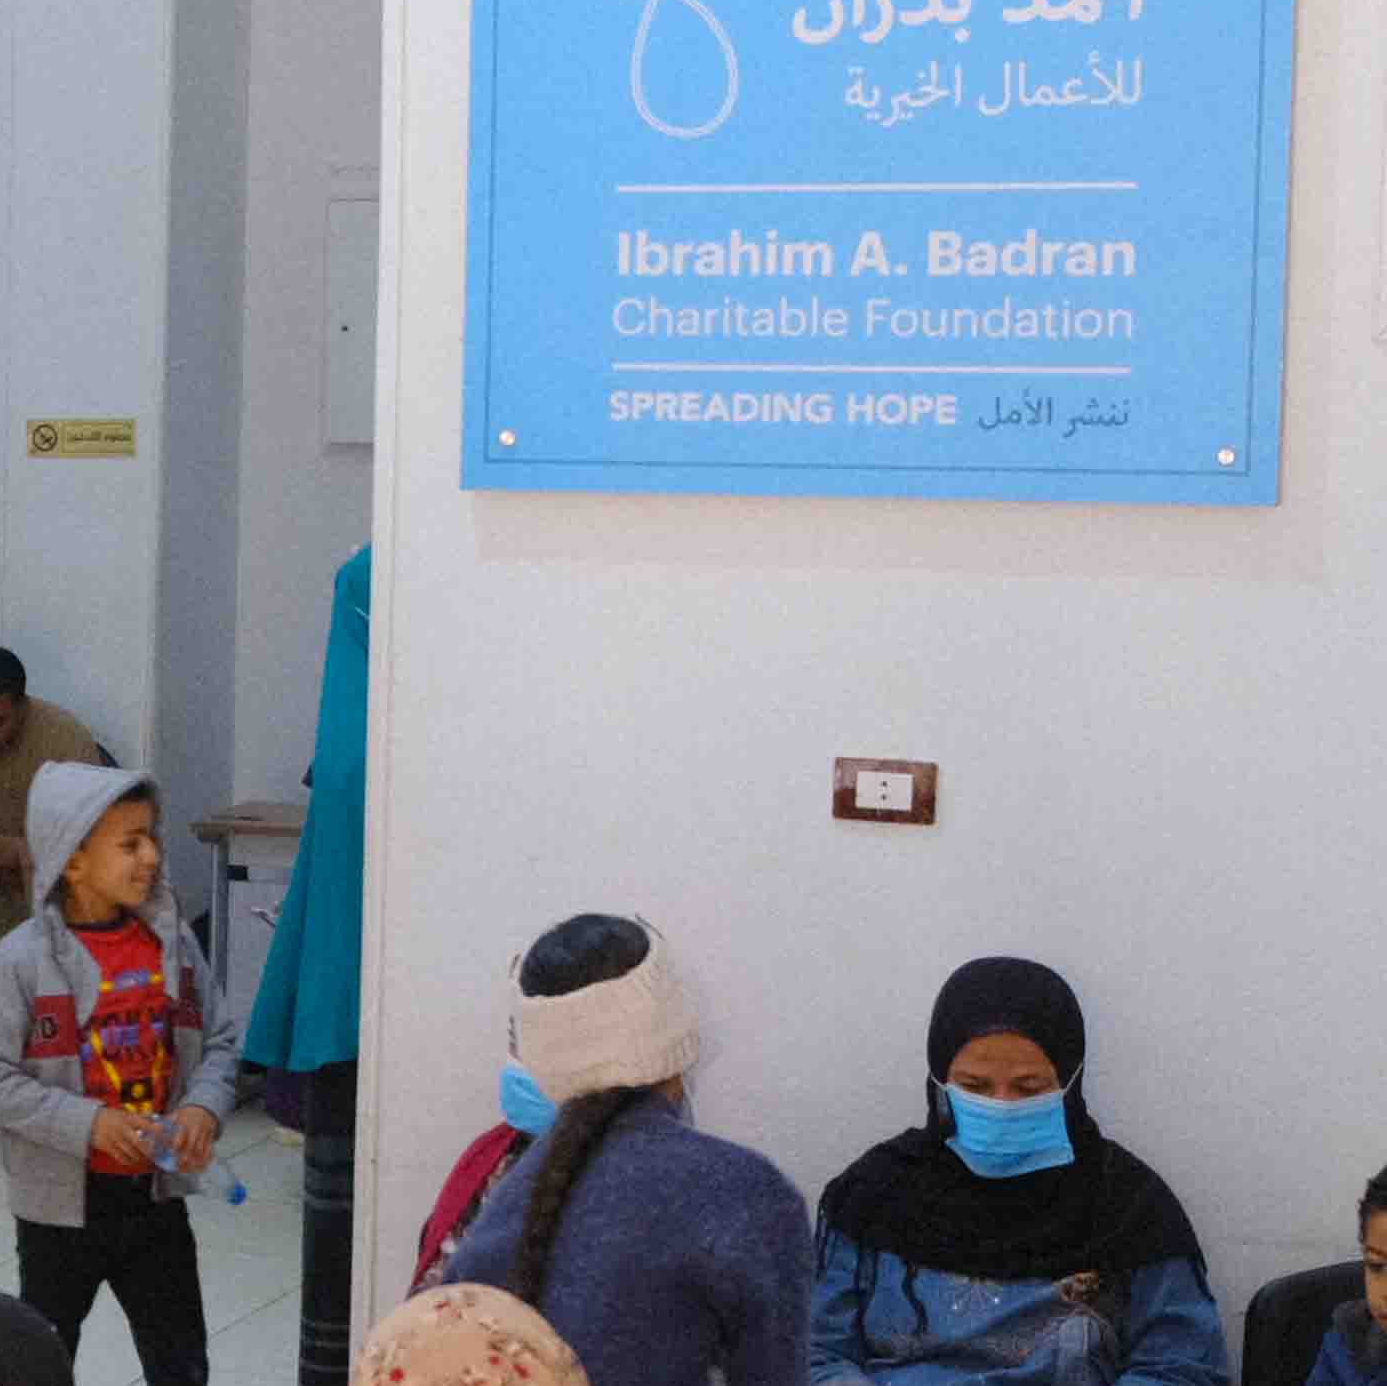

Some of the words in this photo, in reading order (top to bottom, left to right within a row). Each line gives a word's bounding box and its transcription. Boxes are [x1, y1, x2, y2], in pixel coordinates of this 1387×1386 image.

[844, 60, 963, 128] الخيرية
[978, 50, 1143, 115] للأعمال
[618, 228, 834, 278] Ibrahim
[850, 230, 908, 278] A.
[927, 228, 1136, 278] Badran
[612, 296, 849, 337] Charitable
[866, 297, 1134, 339] Foundation
[610, 390, 834, 424] SPREADING
[847, 393, 957, 425] HOPE
[977, 381, 1052, 431] الأمل
[1062, 396, 1130, 439] ننشر
